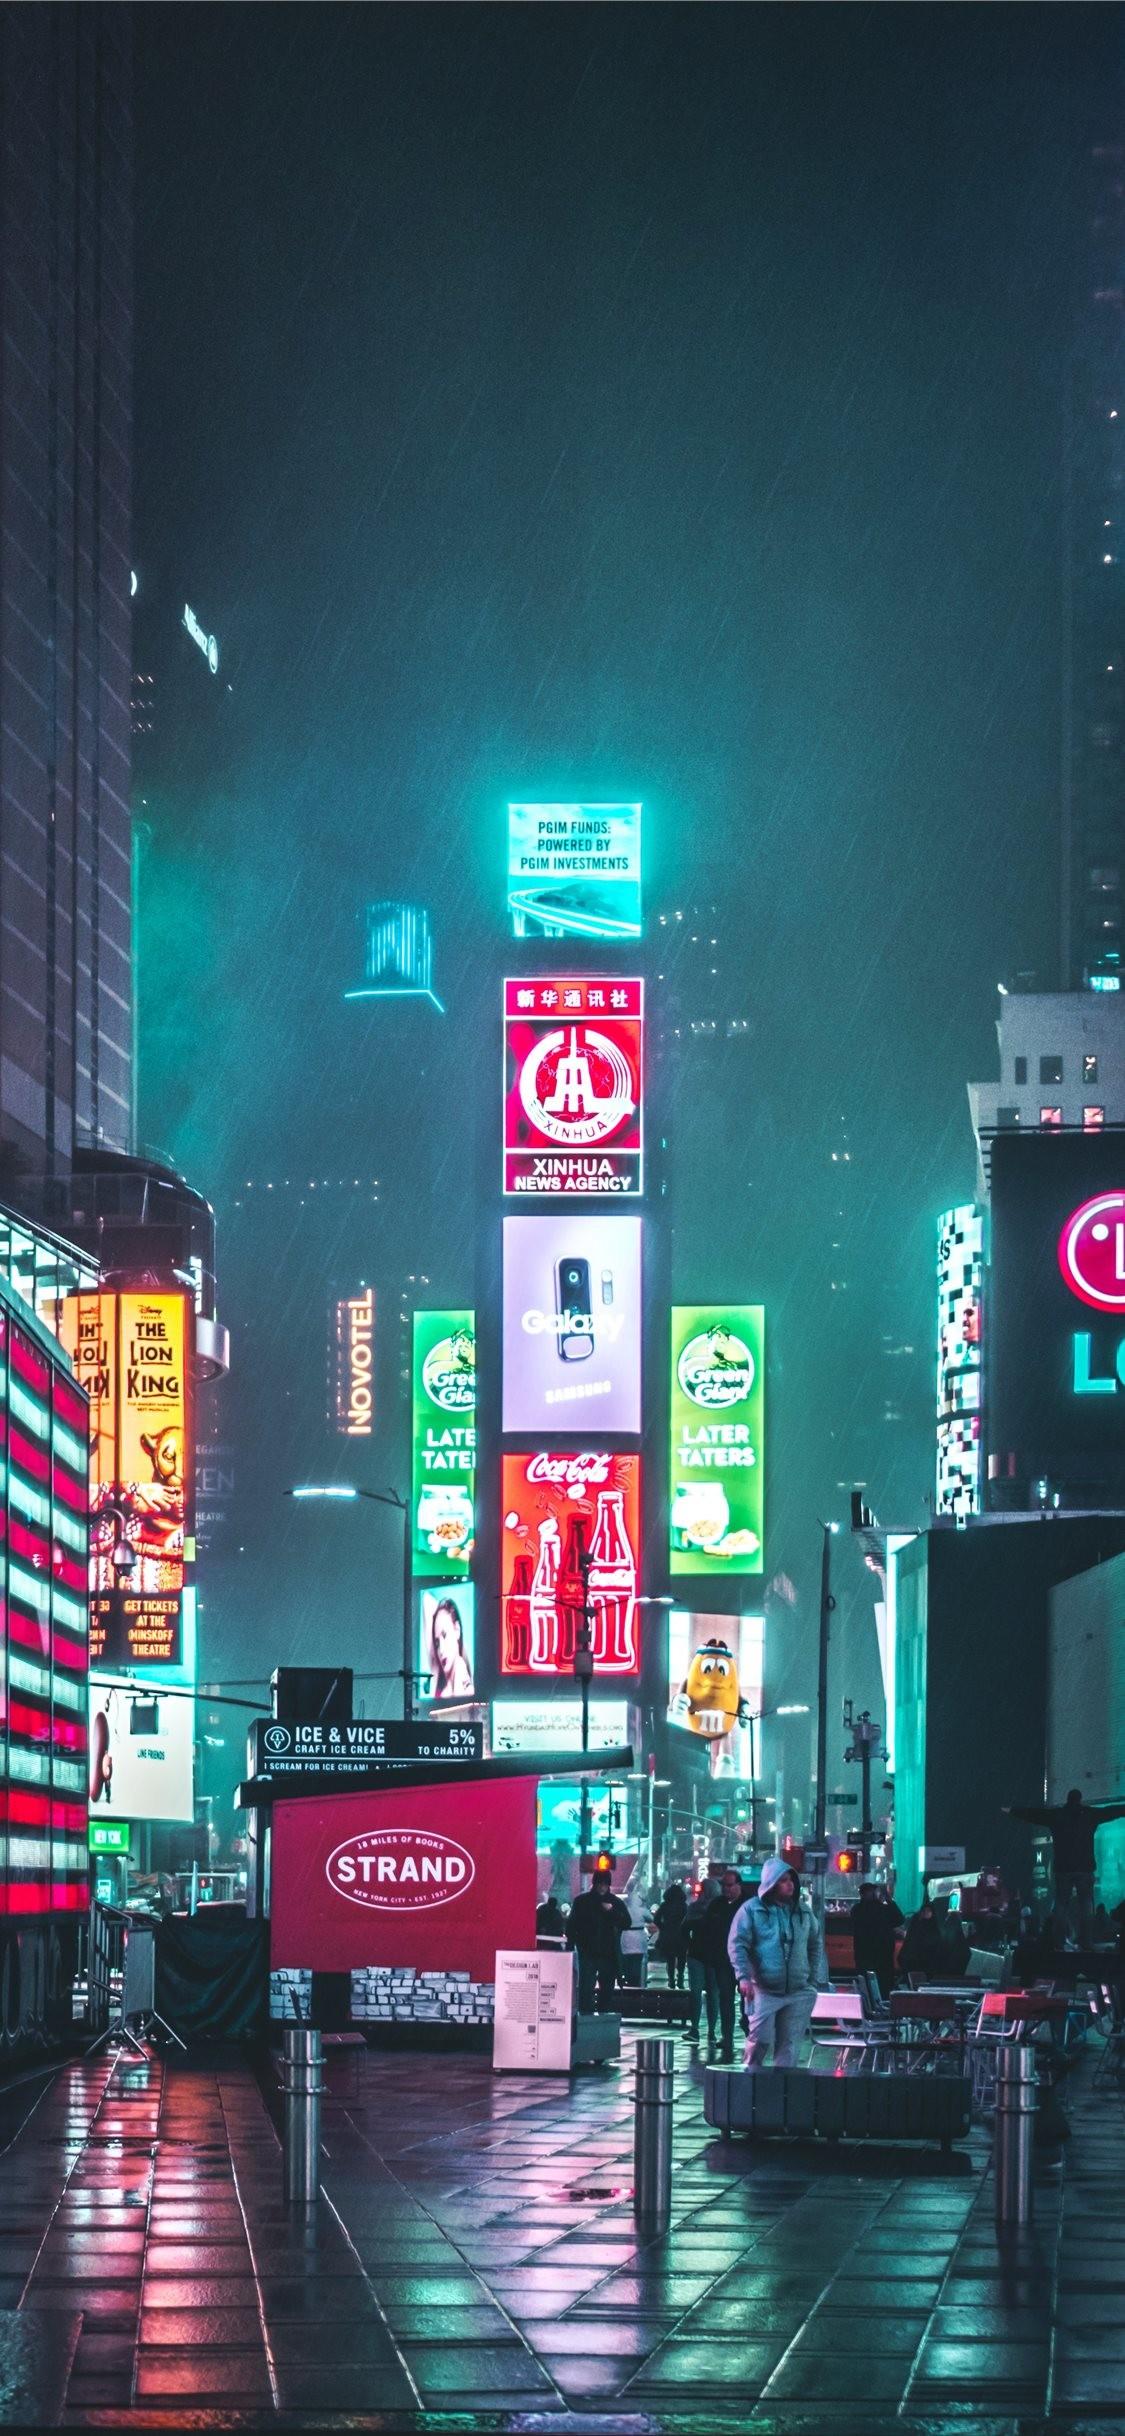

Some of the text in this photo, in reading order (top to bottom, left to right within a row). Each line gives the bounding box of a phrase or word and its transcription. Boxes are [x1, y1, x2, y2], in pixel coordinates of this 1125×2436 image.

[538, 821, 611, 834] PGIM FUNDS:
[538, 839, 611, 852] POWERED BY
[521, 857, 629, 870] PGIM INVESTMENTS
[544, 1120, 607, 1140] XINHUA
[532, 1158, 614, 1176] XINHUA
[514, 1176, 632, 1191] NEWS AGENCY
[135, 1322, 167, 1337] THE
[521, 1309, 626, 1344] Galaxy
[347, 1288, 373, 1434] NOVOTEL
[688, 1366, 748, 1384] Green
[438, 1386, 475, 1404] Gia
[545, 1381, 612, 1404] SAMSUNG
[696, 1382, 748, 1402] Giant
[682, 1424, 750, 1444] LATER
[677, 1446, 755, 1467] TATERS
[124, 1600, 179, 1614] GET TICKETS
[136, 1615, 166, 1628] AT THE
[128, 1630, 173, 1641] MINSKOFF
[133, 1644, 170, 1656] THEATRE
[295, 1726, 385, 1743] ICE & VICE
[449, 1729, 475, 1745] 5%
[295, 1744, 385, 1755] CRAFT ICE CREAM
[418, 1746, 475, 1756] TO CHARITY
[269, 1762, 302, 1770] SCREAM
[337, 1763, 369, 1771] CREAM!
[357, 1835, 444, 1850] 18 MILES OF BOOKS
[337, 1856, 466, 1882] STRAND
[353, 1888, 368, 1898] NEW
[370, 1894, 388, 1903] YORK
